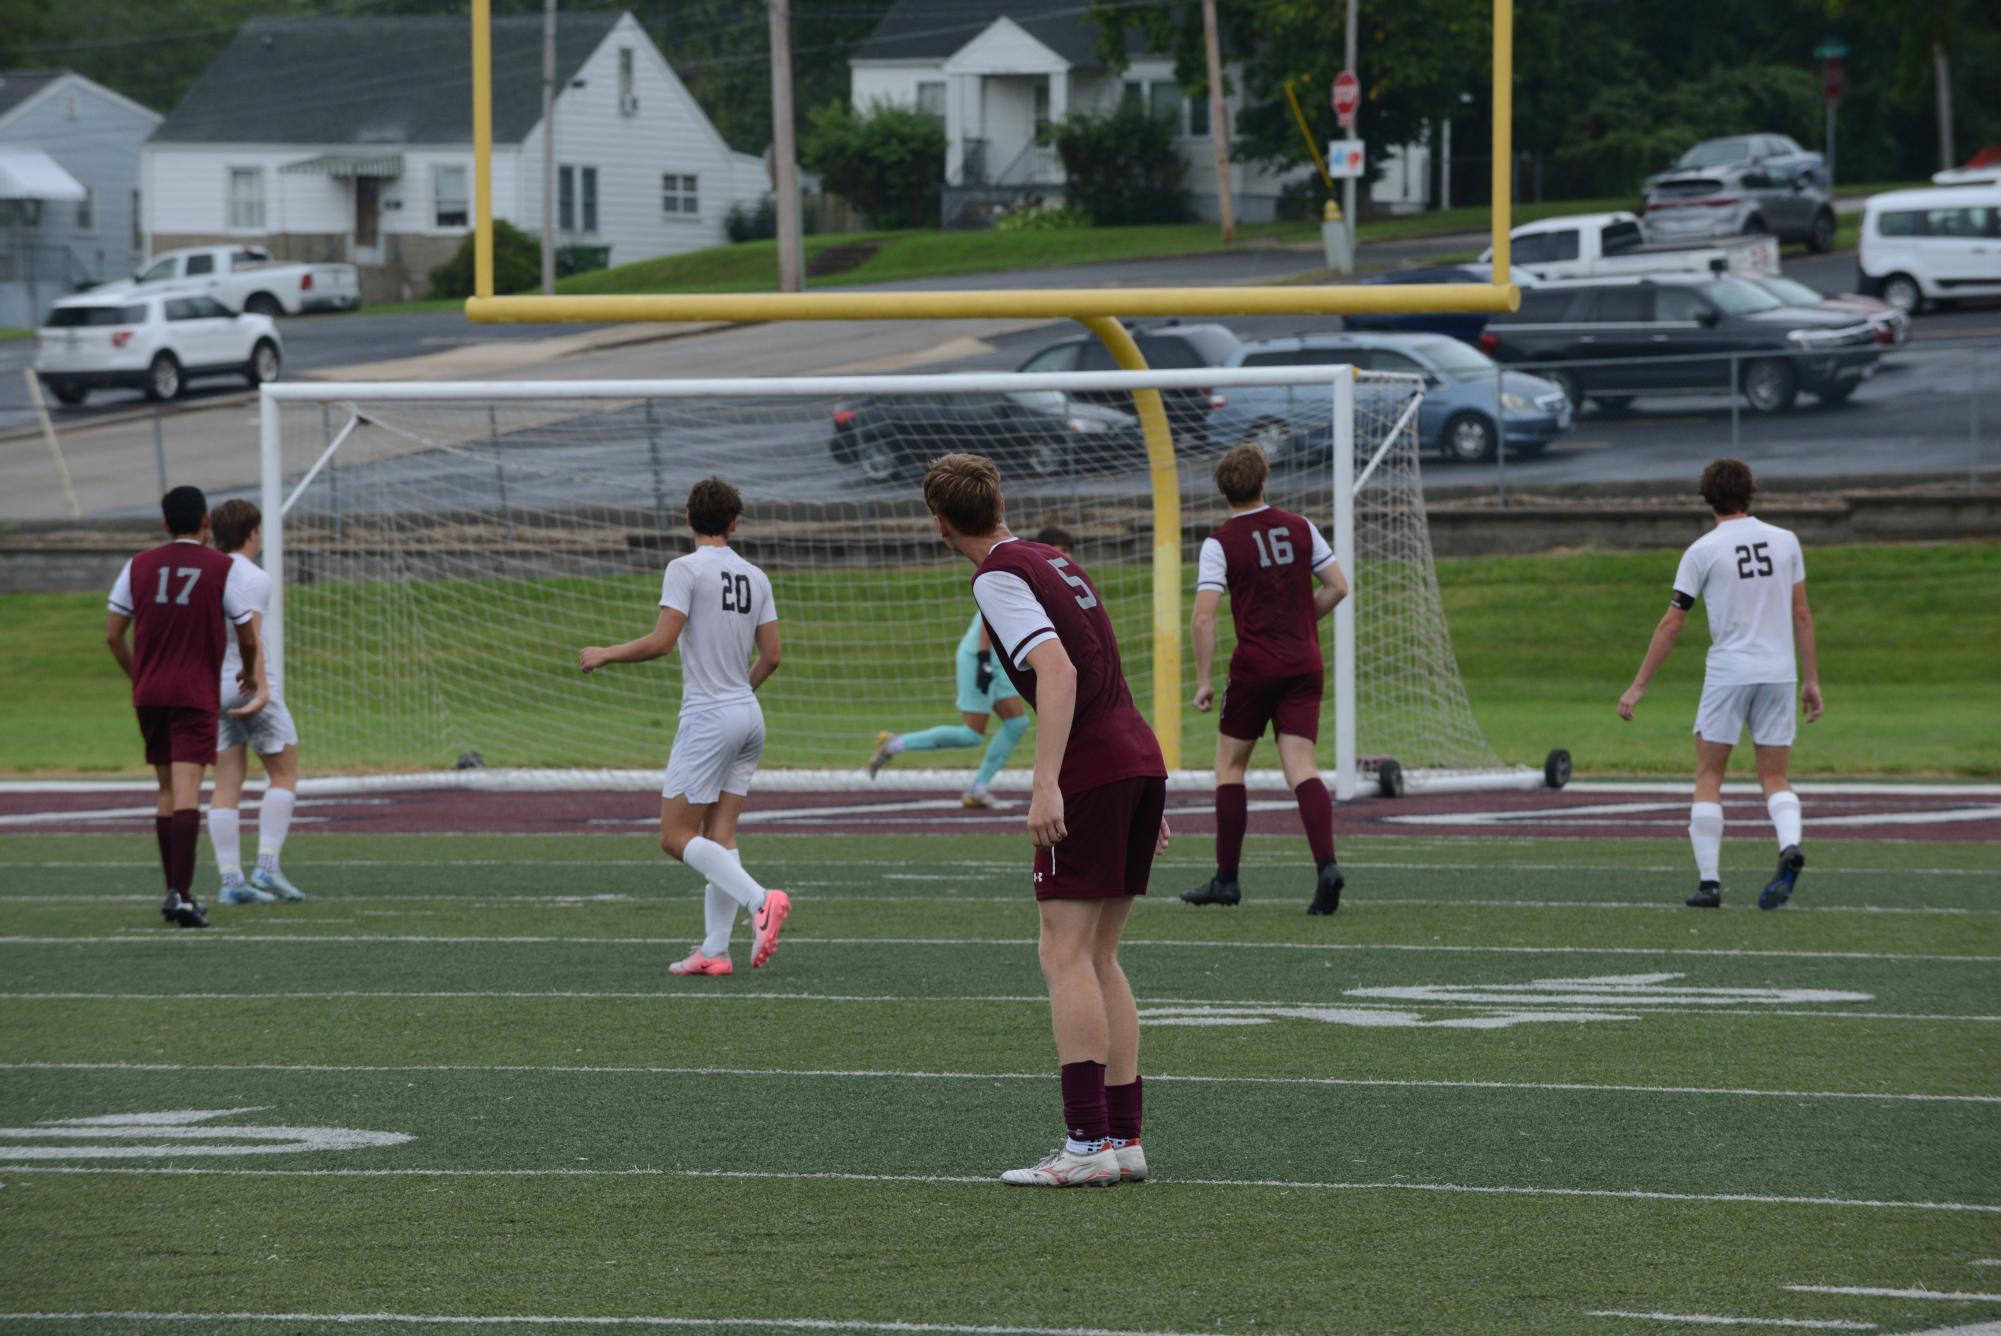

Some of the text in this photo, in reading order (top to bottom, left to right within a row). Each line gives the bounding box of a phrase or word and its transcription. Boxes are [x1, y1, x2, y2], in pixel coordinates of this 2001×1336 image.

[1252, 526, 1294, 568] 16
[1735, 541, 1773, 579] 25
[155, 566, 202, 605] 17
[721, 571, 751, 614] 20
[1047, 556, 1097, 610] 5
